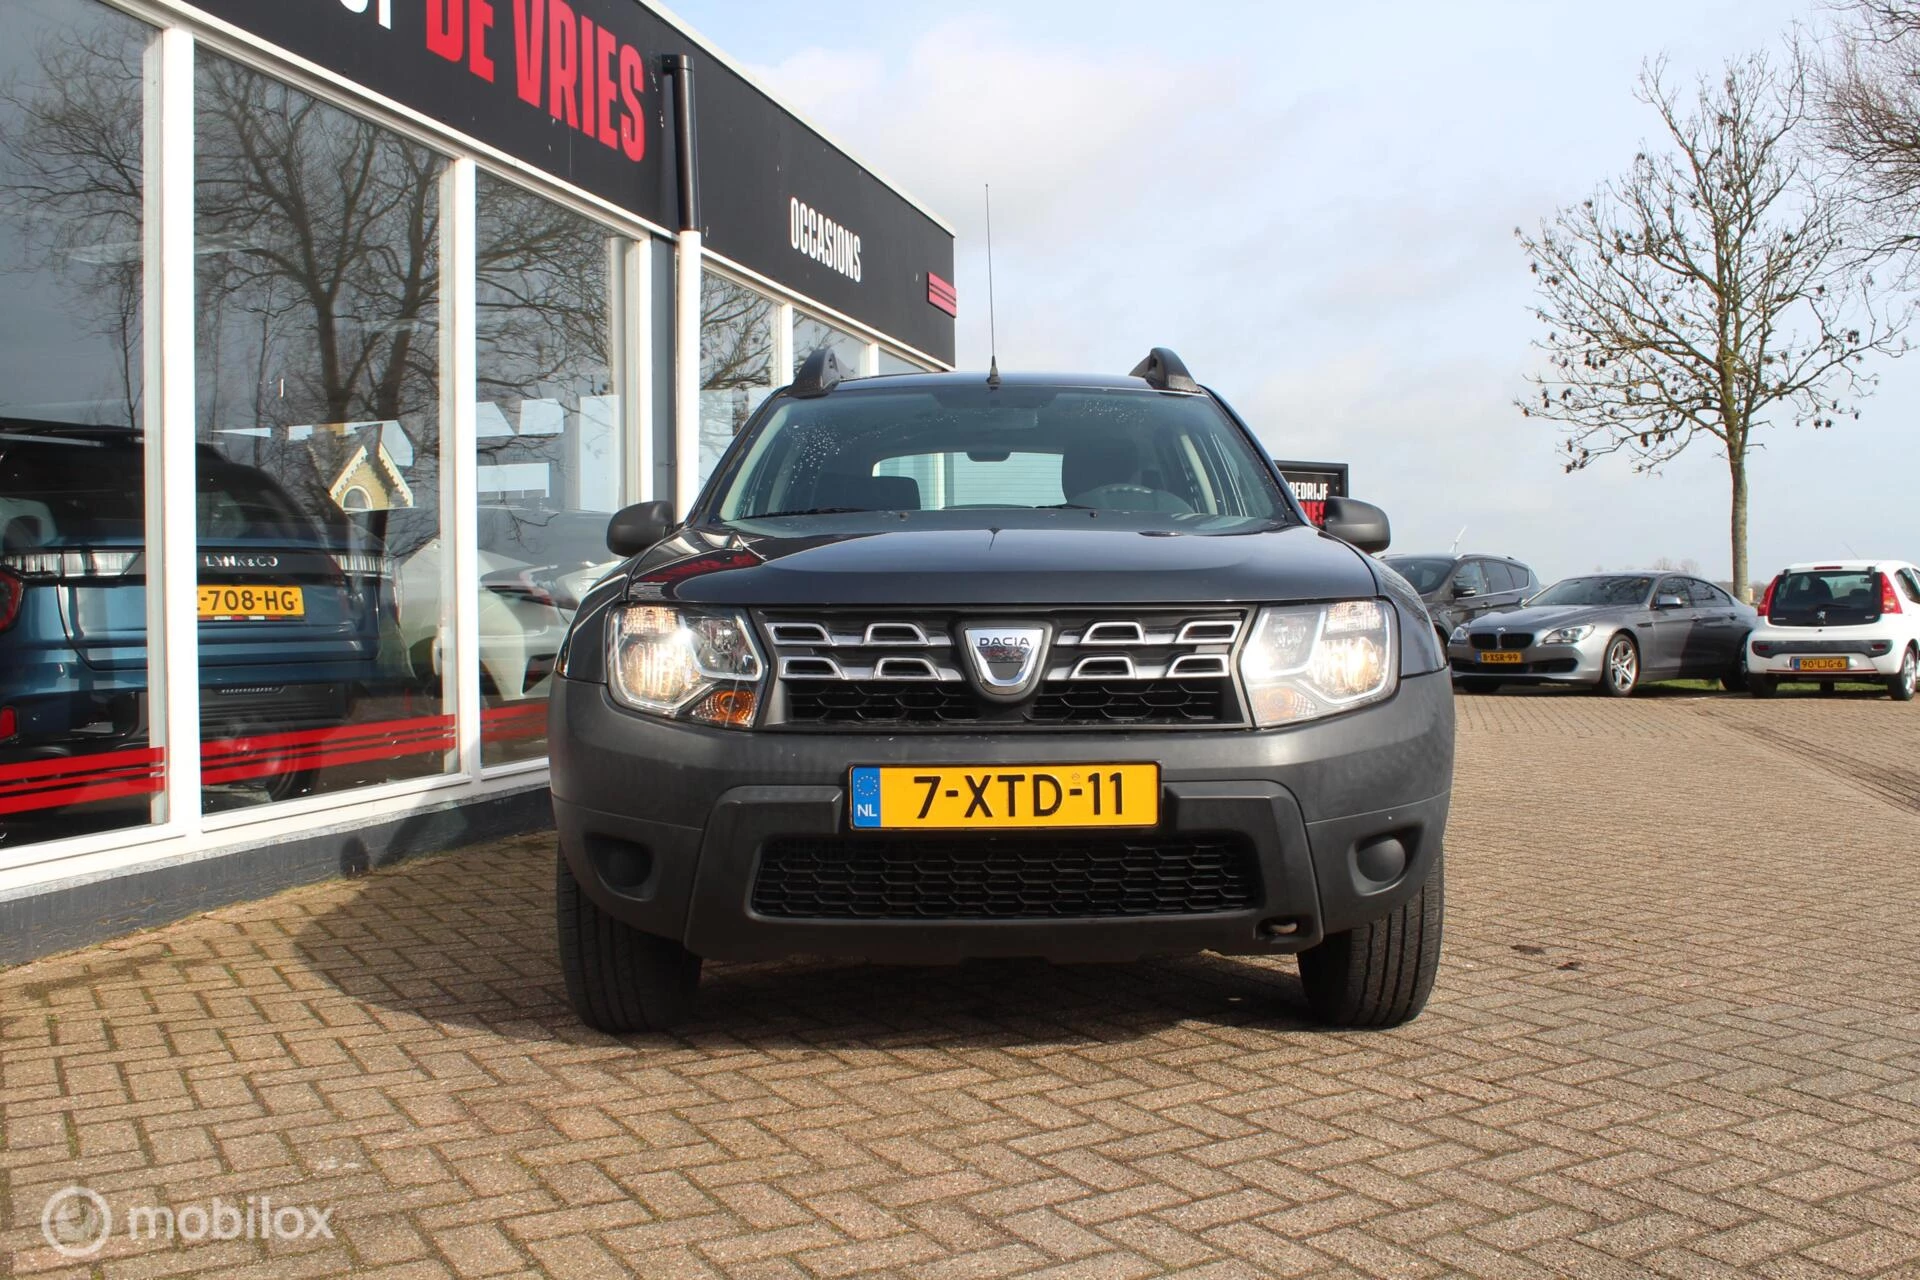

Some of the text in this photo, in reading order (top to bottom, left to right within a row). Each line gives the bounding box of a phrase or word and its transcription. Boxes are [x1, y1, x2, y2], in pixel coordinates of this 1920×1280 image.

[513, 0, 645, 162] VRIES
[790, 197, 861, 282] OCCASIONS
[197, 589, 296, 611] -708-HG
[979, 636, 1030, 647] DACIA
[857, 804, 878, 817] NL
[913, 772, 1123, 819] 7-XTD-11
